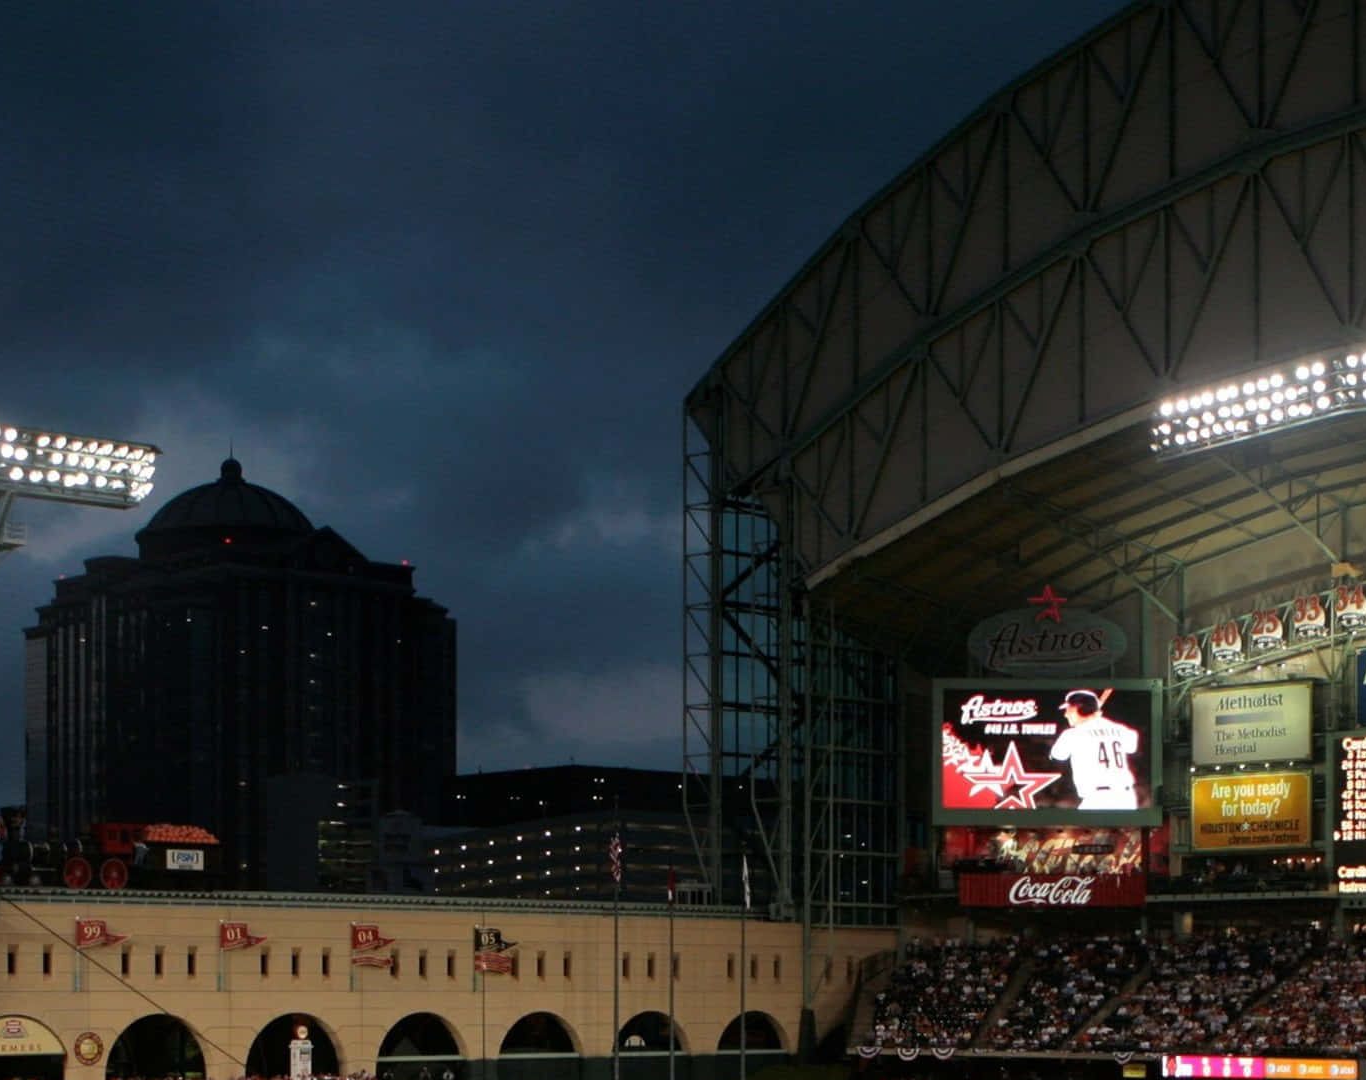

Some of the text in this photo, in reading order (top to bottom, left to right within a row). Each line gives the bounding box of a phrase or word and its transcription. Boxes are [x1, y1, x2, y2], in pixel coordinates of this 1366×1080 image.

[1294, 594, 1322, 623] 33
[1336, 584, 1364, 611] 34
[1211, 621, 1239, 647] 40
[1251, 609, 1279, 635] 25
[989, 622, 1104, 668] Astros
[1172, 635, 1198, 661] 32
[960, 694, 1038, 725] Astros
[1216, 726, 1287, 742] The Methodist
[1098, 741, 1123, 769] 46
[1216, 742, 1257, 757] Hospital
[1211, 779, 1291, 801] Are you ready
[1221, 798, 1281, 818] for today?
[1200, 822, 1242, 834] HOUSTON
[84, 926, 101, 938] 99
[226, 927, 242, 940] 01
[358, 930, 373, 943] 04
